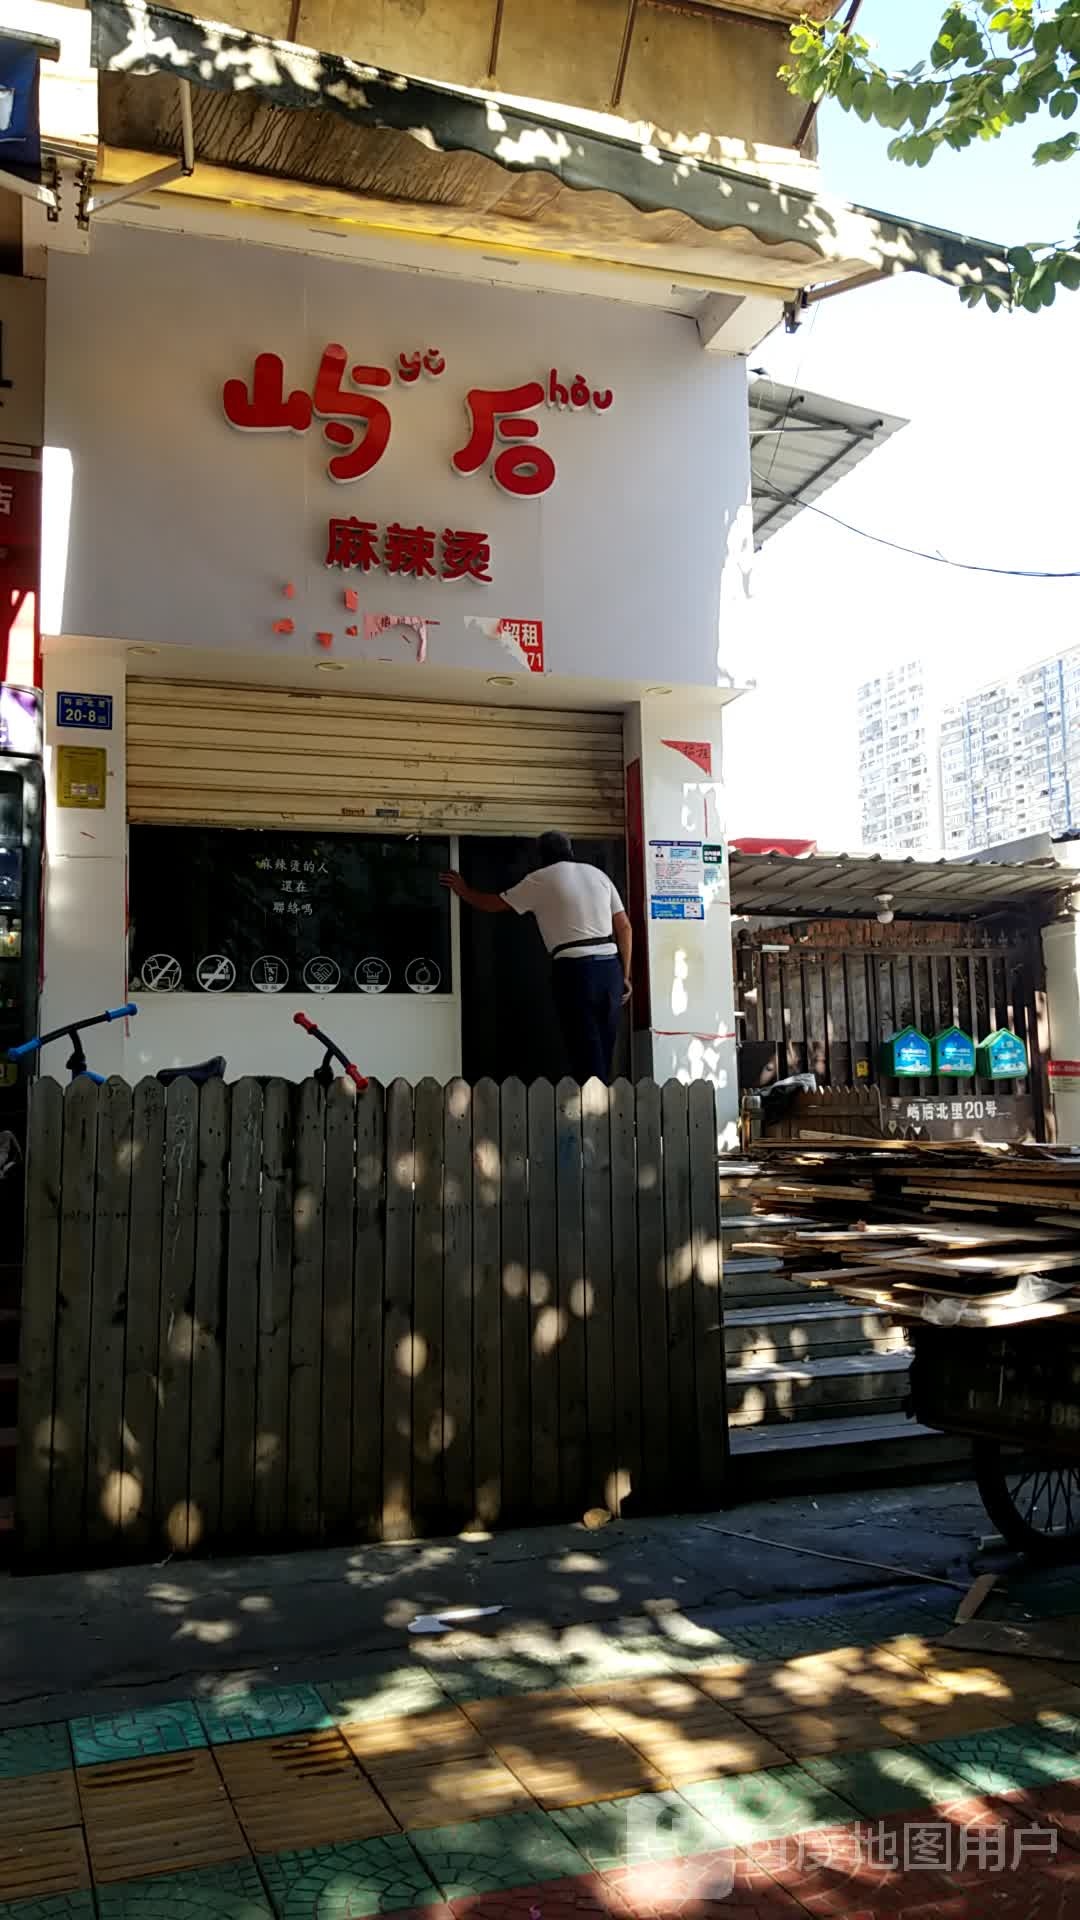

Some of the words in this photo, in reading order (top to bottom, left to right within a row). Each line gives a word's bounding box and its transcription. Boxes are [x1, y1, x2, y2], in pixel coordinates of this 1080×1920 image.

[325, 516, 493, 583] 麻辣烫
[906, 1100, 998, 1121] 屿后北里20号
